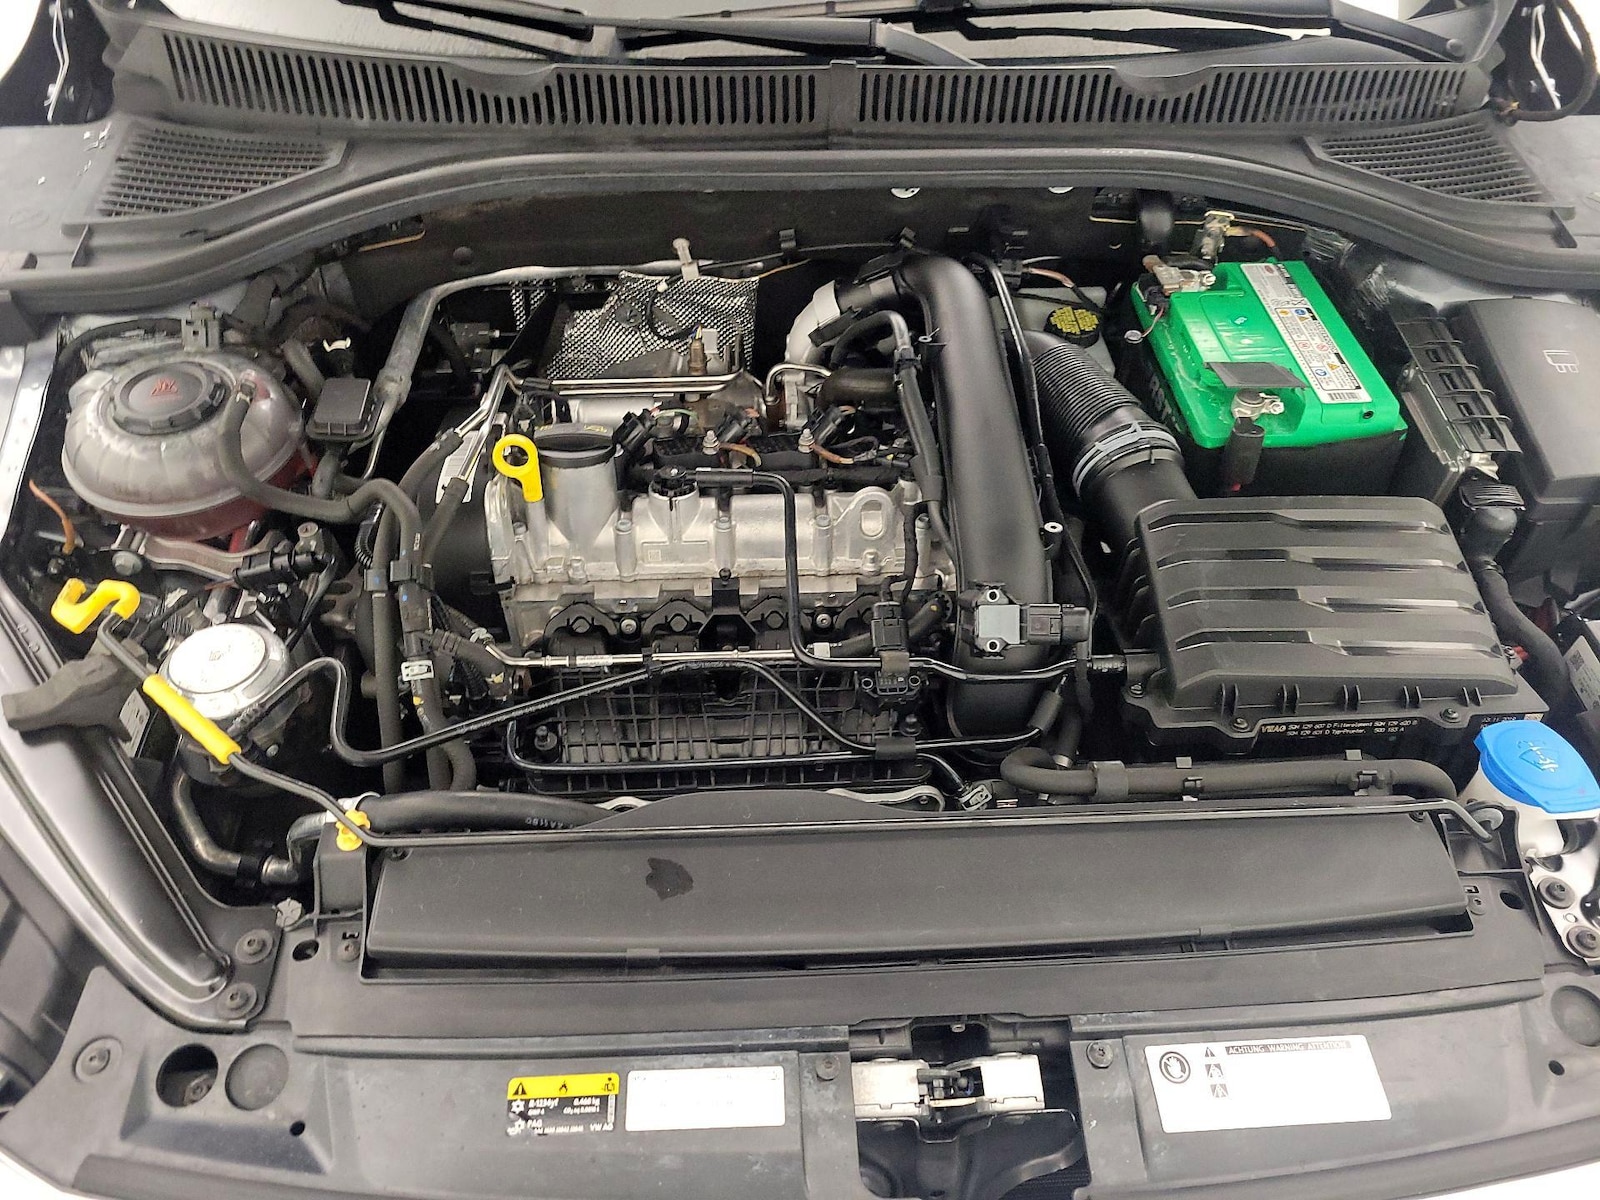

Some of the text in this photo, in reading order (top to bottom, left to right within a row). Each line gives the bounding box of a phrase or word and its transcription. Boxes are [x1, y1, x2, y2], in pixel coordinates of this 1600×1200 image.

[1228, 1041, 1346, 1055] ACHTUNG WARNING ATTENTION
[527, 1119, 543, 1128] PAG
[590, 1123, 602, 1131] VW
[602, 1122, 614, 1131] AG
